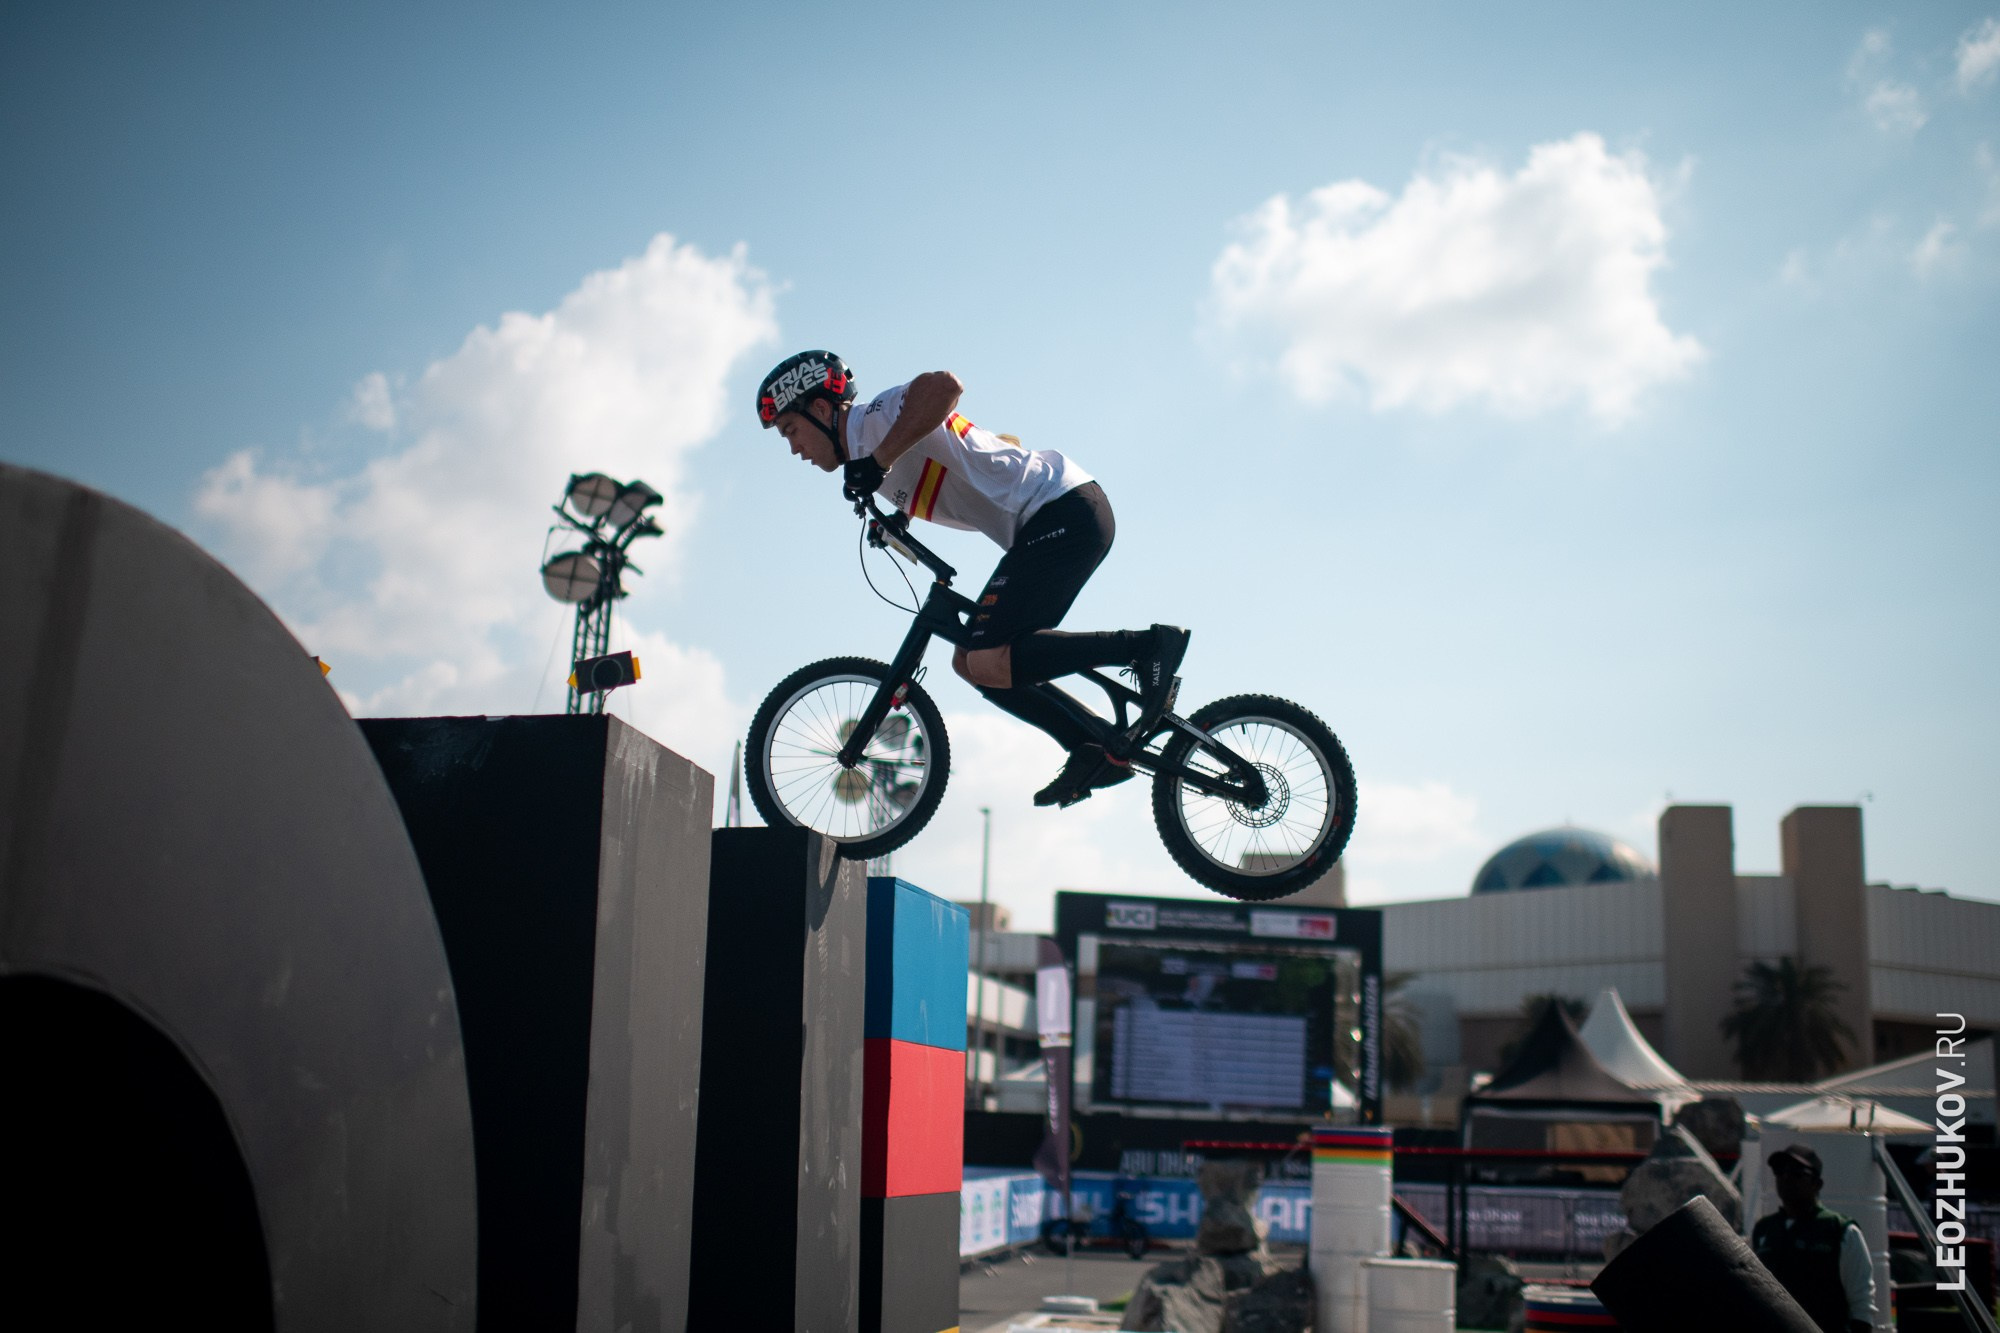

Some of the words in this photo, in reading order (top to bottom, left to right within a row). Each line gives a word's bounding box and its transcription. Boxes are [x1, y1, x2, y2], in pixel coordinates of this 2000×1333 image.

[767, 358, 825, 397] TRIAL
[772, 365, 829, 412] BIKES
[1113, 908, 1152, 926] UCI
[1157, 1151, 1205, 1175] DHAB
[1601, 1212, 1628, 1227] Dha
